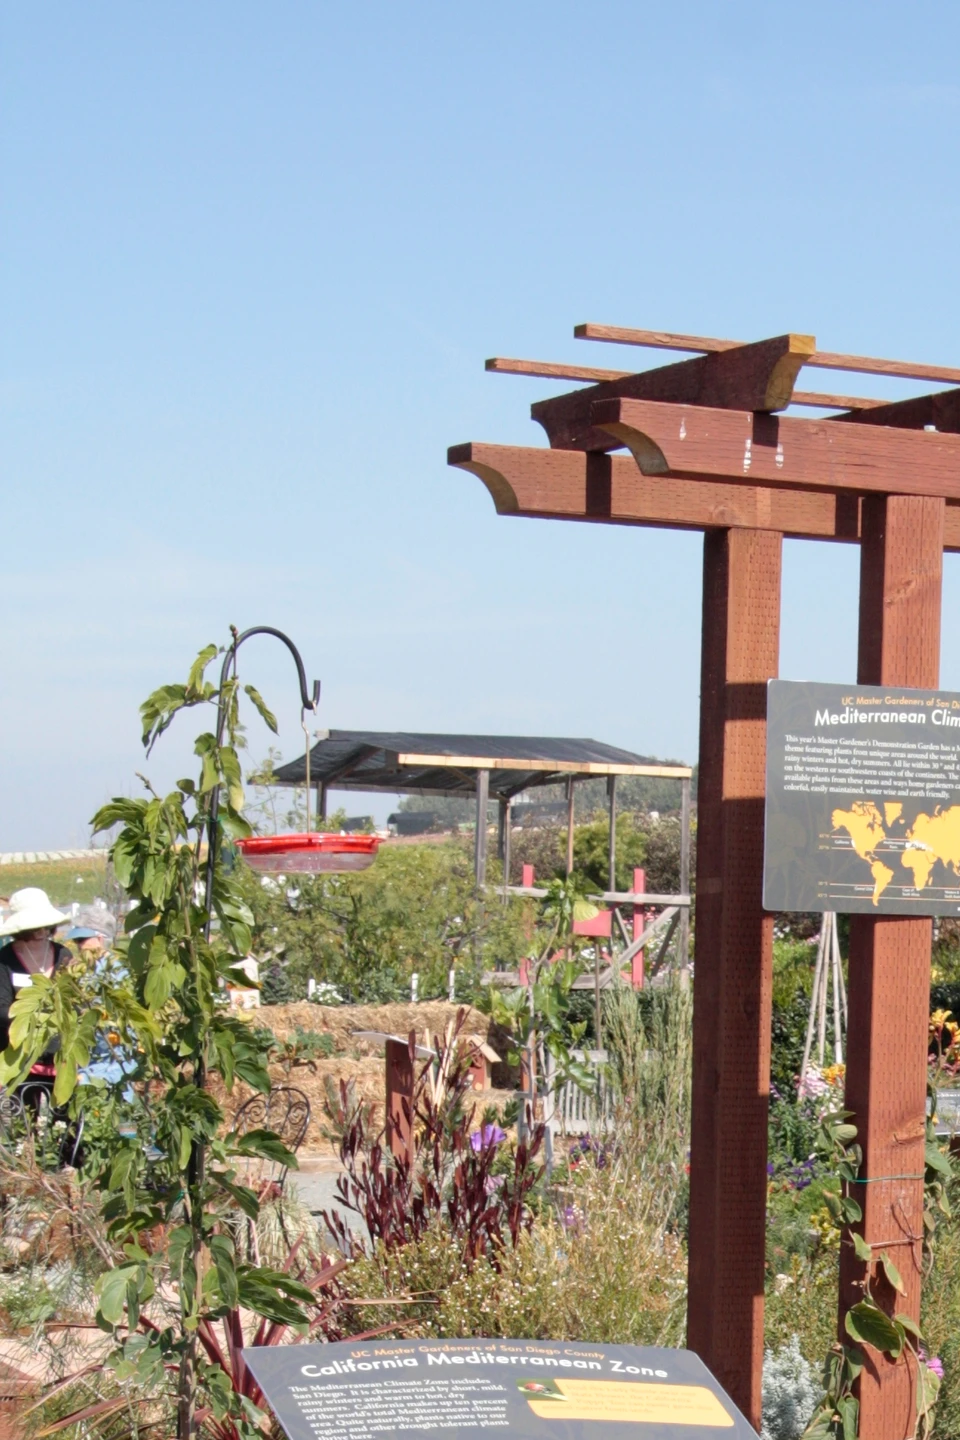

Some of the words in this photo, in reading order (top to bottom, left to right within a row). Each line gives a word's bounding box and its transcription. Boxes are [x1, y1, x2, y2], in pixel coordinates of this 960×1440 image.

[842, 697, 854, 705] UC
[856, 697, 882, 705] Master
[885, 696, 924, 706] Gardeners
[936, 699, 949, 708] San
[815, 707, 925, 726] Mediterranean
[800, 736, 815, 744] year's
[840, 738, 871, 746] Gardener's
[873, 740, 916, 749] Demonstration
[918, 743, 939, 751] Garden
[805, 746, 832, 756] featuring
[834, 748, 852, 756] plants
[870, 750, 889, 758] unique
[785, 755, 800, 763] rainy
[851, 758, 861, 766] dry
[838, 766, 877, 775] southwestern
[926, 781, 953, 789] gardeners
[926, 789, 950, 799] friendly.
[375, 1348, 415, 1356] Master
[419, 1344, 481, 1353] Gardeners
[526, 1346, 560, 1355] Diego
[565, 1349, 605, 1360] County
[301, 1356, 418, 1377] California
[427, 1351, 601, 1370] Mediterranean
[610, 1360, 668, 1377] Zone
[311, 1382, 382, 1391] Mediterranean
[372, 1387, 435, 1395] characterized
[355, 1402, 405, 1410] California
[398, 1407, 469, 1416] Mediterranean
